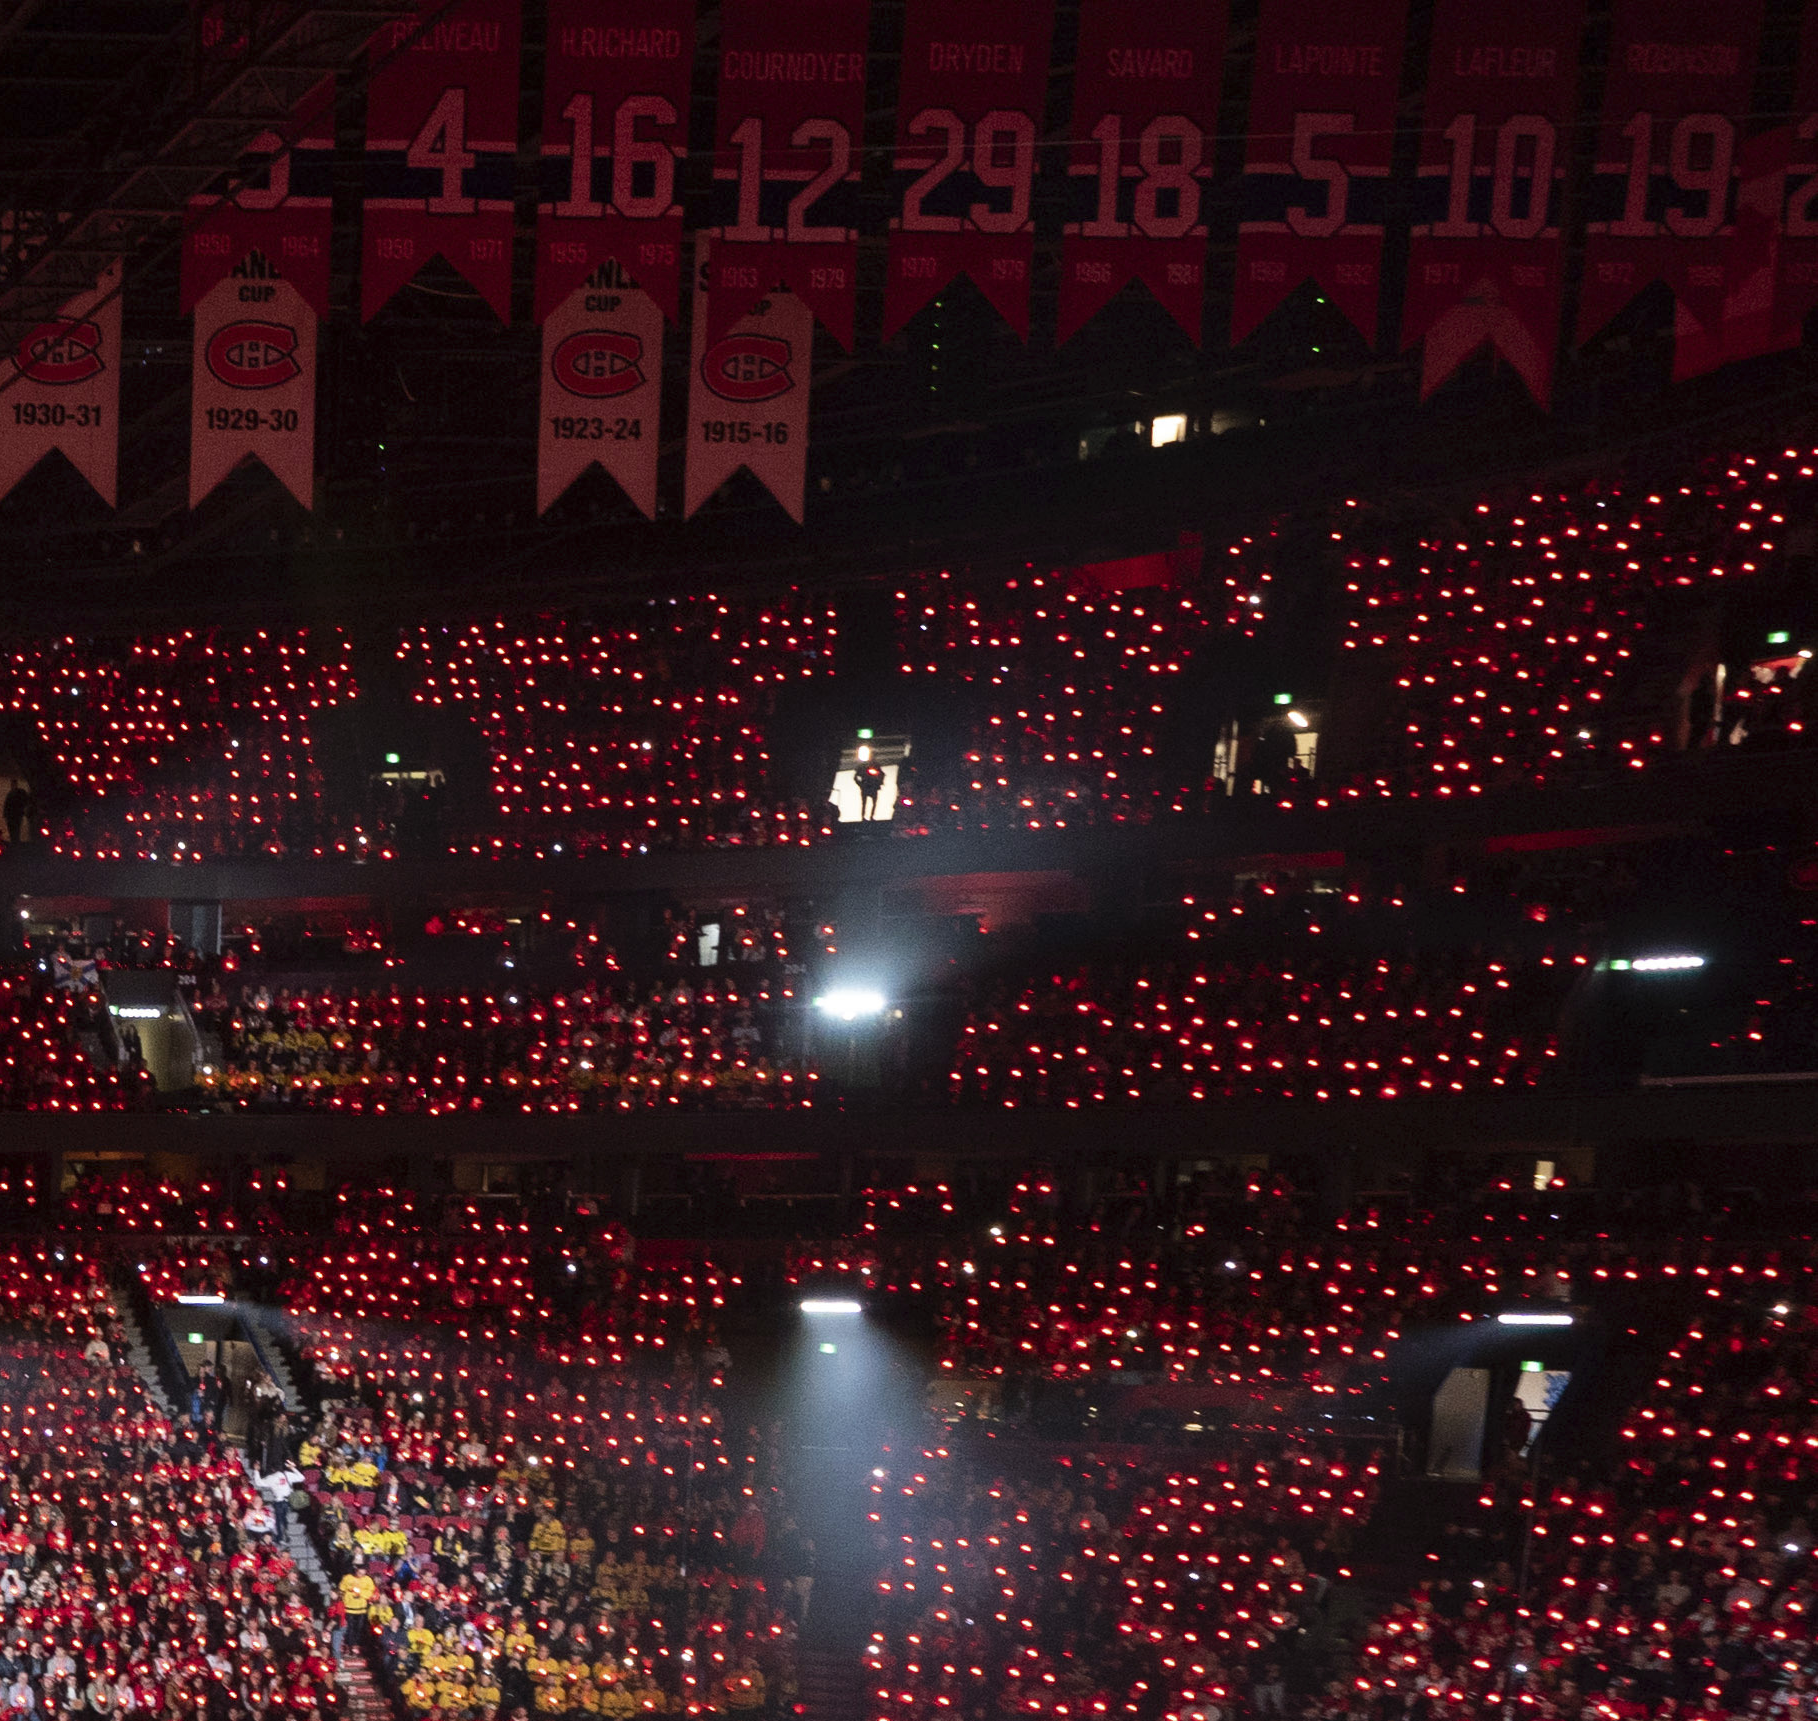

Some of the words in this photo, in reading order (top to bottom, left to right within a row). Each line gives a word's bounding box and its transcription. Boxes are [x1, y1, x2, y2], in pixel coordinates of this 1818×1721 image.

[724, 48, 864, 84] COURNOYER
[929, 41, 1024, 75] DRYDEN
[1107, 48, 1194, 79] SAVARD
[1274, 43, 1383, 77] LAPOINTE
[1454, 45, 1557, 79] LAFLEUR
[405, 86, 477, 215] 4
[561, 93, 679, 218] 16
[725, 116, 853, 242] 12
[900, 108, 1036, 234] 29
[1078, 113, 1205, 240] 18
[1286, 111, 1356, 238] 5
[1429, 112, 1558, 239] 10
[1606, 111, 1736, 239] 19
[280, 235, 320, 257] 1964
[238, 285, 277, 303] CUP
[584, 295, 622, 312] CUP
[12, 402, 103, 427] 1930-31
[205, 407, 298, 431] 1929-30
[551, 416, 642, 440] 1923-24
[701, 419, 788, 444] 1915-16
